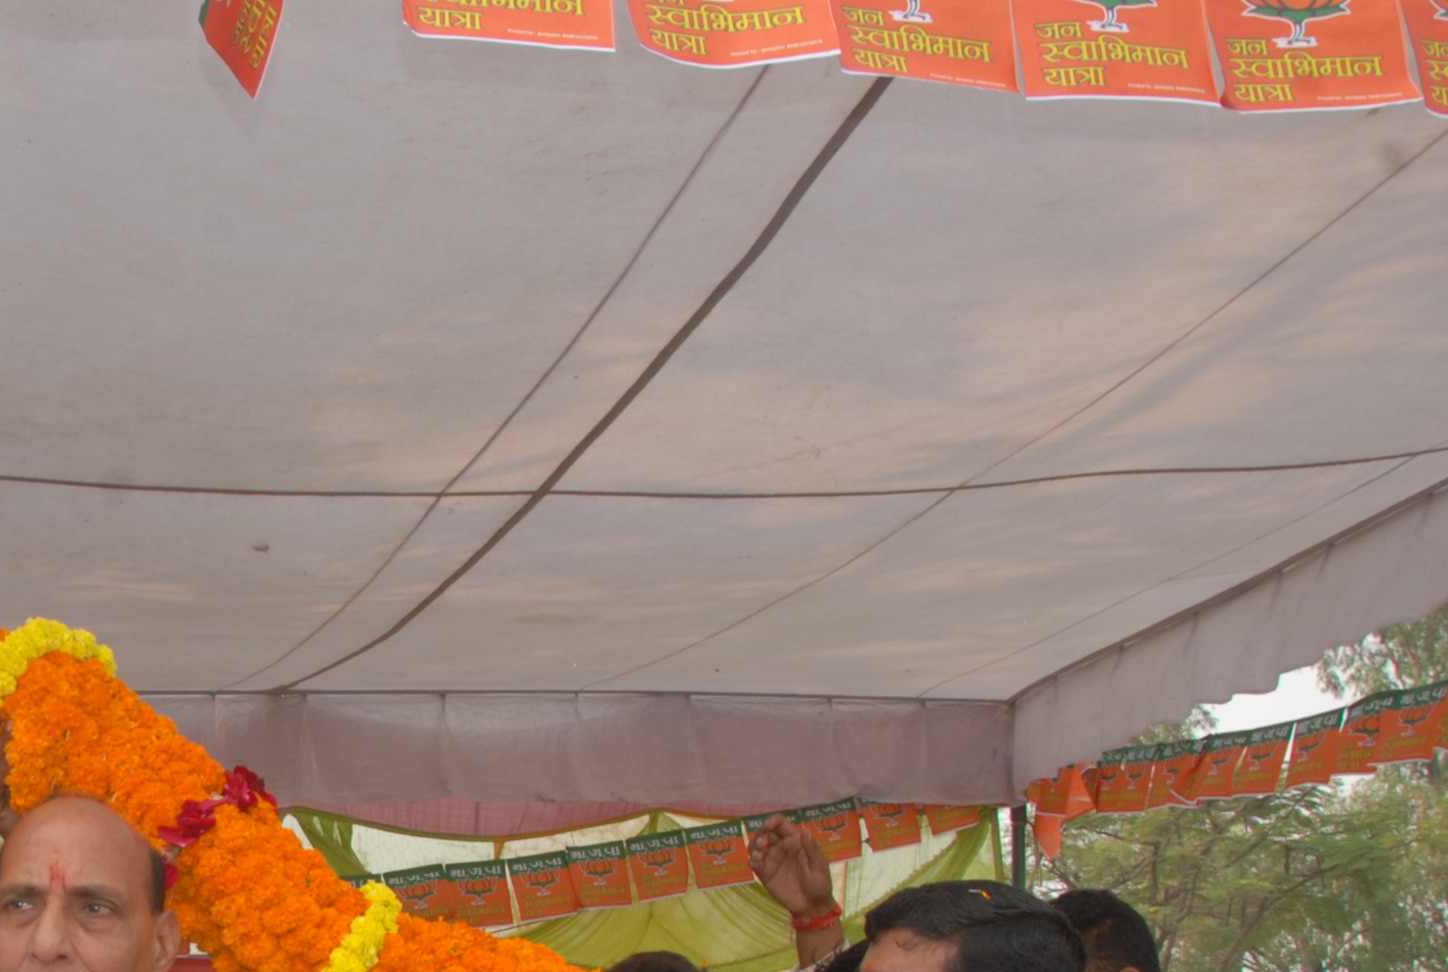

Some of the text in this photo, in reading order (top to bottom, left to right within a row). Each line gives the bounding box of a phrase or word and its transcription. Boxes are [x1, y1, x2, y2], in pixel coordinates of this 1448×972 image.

[418, 6, 483, 30] यात्रा
[645, 4, 806, 32] स्वाभिमान
[842, 5, 884, 27] जन
[650, 28, 706, 55] यात्रा
[1035, 21, 1083, 39] जन
[847, 24, 992, 63] स्वाभिमान
[1039, 33, 1191, 69] स्वाभिमान
[1226, 37, 1269, 56] जन
[851, 47, 910, 73] यात्रा
[1229, 50, 1384, 79] स्वाभिमान
[1042, 66, 1106, 87] यात्रा
[1232, 83, 1295, 103] यात्रा
